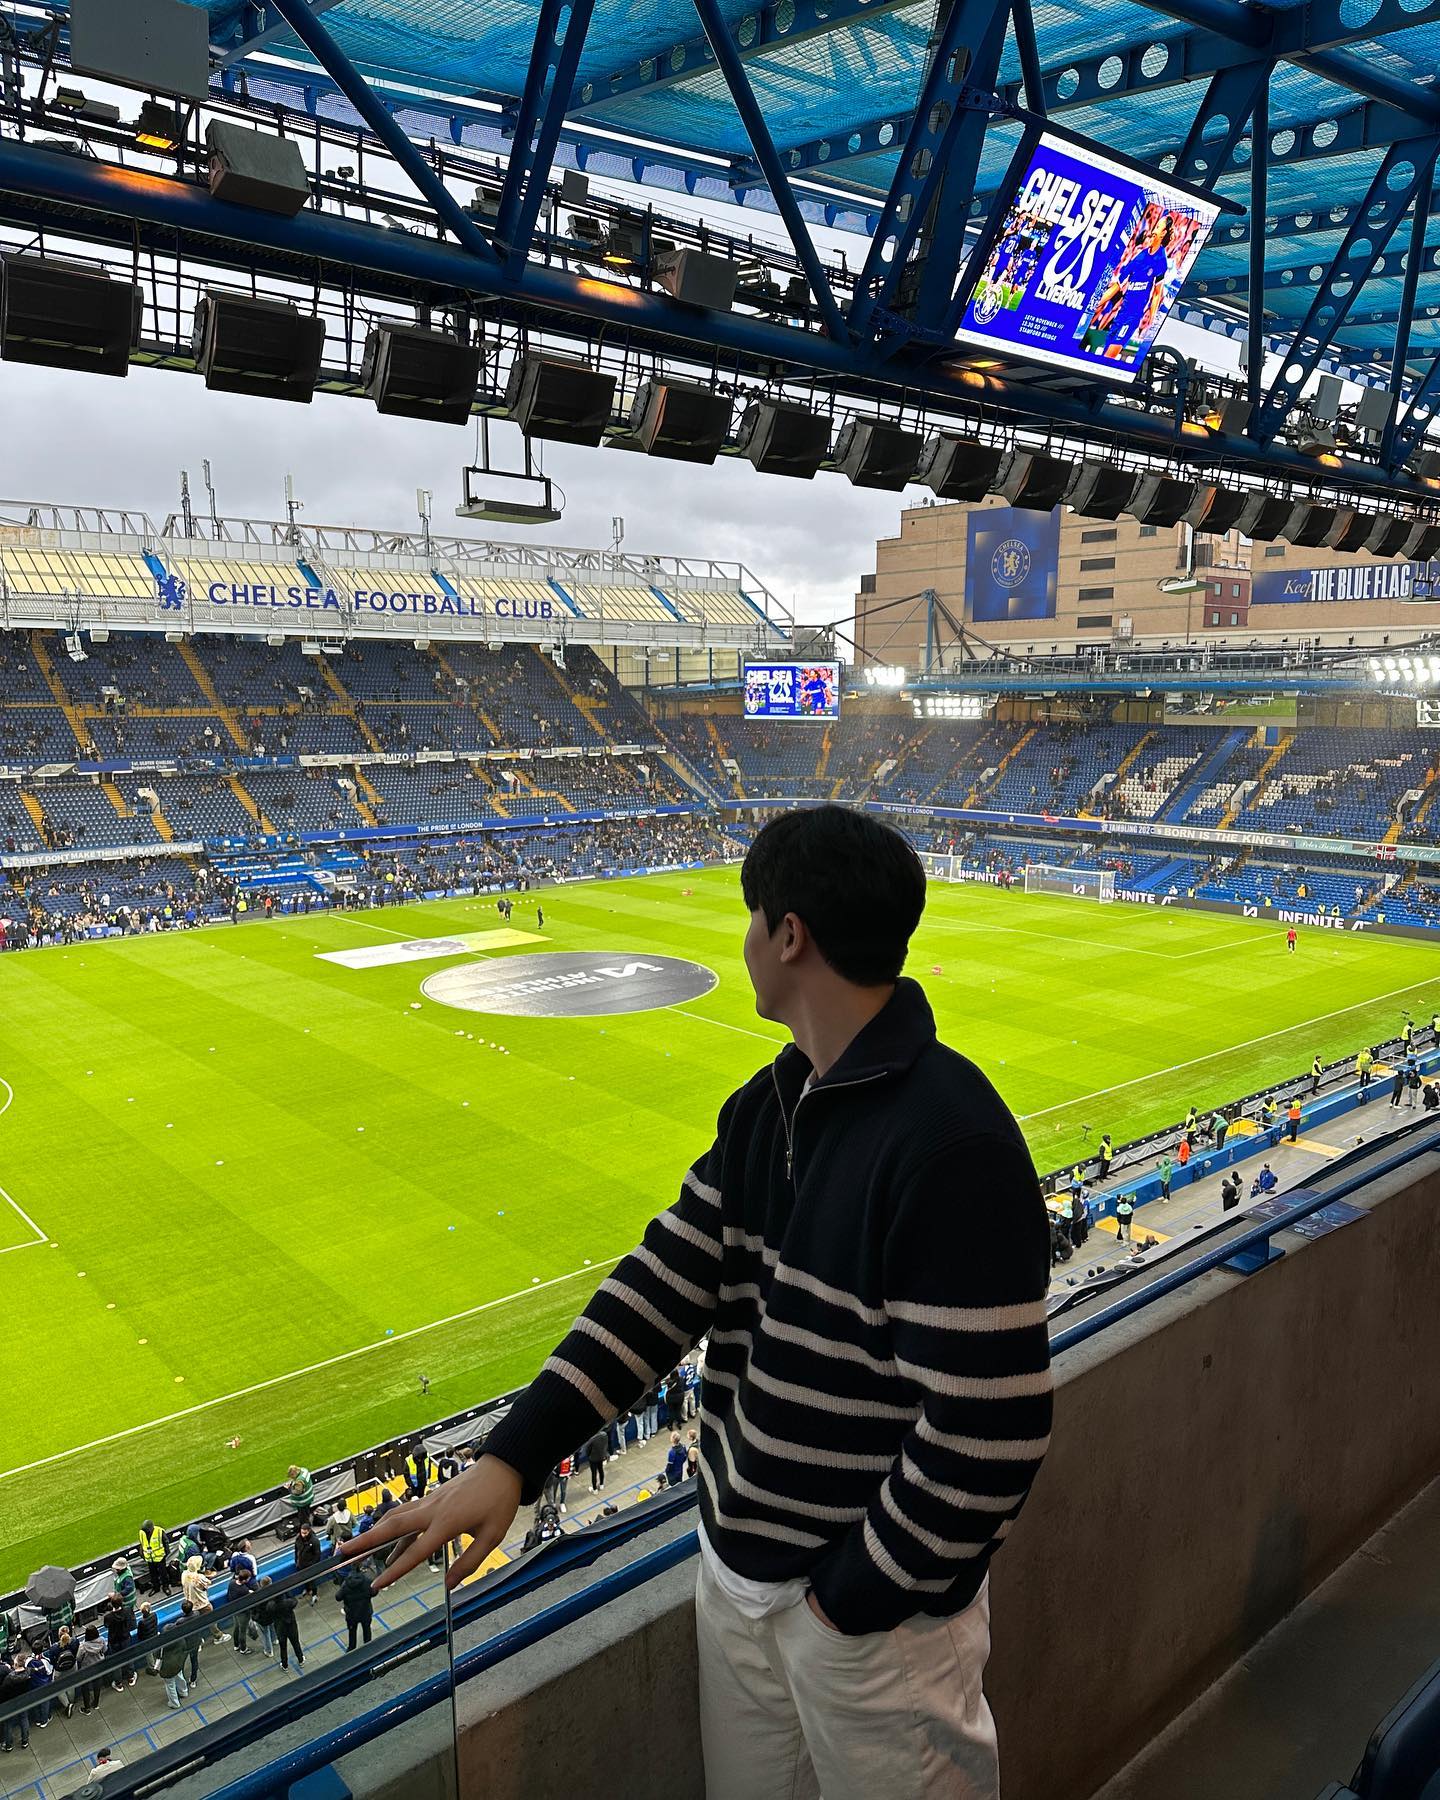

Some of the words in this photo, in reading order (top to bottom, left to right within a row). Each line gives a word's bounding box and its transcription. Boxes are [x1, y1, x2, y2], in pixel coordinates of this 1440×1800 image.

[1018, 168, 1124, 252] CHELSEA
[1034, 279, 1086, 310] LIVERPOOL
[1041, 332, 1057, 341] BRIDGE
[999, 541, 1024, 553] CHELSEA
[1283, 579, 1312, 598] Keep
[1311, 569, 1336, 600] THE
[1337, 566, 1372, 600] BLUE
[1374, 564, 1410, 598] FLAG
[208, 582, 340, 609] CHELSEA
[354, 590, 482, 616] FOOTBALL
[495, 598, 554, 619] CLUB
[747, 670, 793, 686] CHELSEA
[387, 753, 409, 761] MIZO
[636, 808, 656, 816] LONDON
[457, 822, 483, 830] LONDON
[1164, 827, 1195, 838] BORN
[1200, 831, 1210, 840] IS
[1216, 832, 1240, 843] THE
[1242, 834, 1273, 845] KING
[21, 856, 43, 864] THEY
[72, 851, 95, 860] MAKE
[98, 849, 120, 857] THEM
[120, 847, 138, 855] LIKE
[1102, 887, 1156, 904] INFINITE
[1278, 910, 1344, 929] INFINITE
